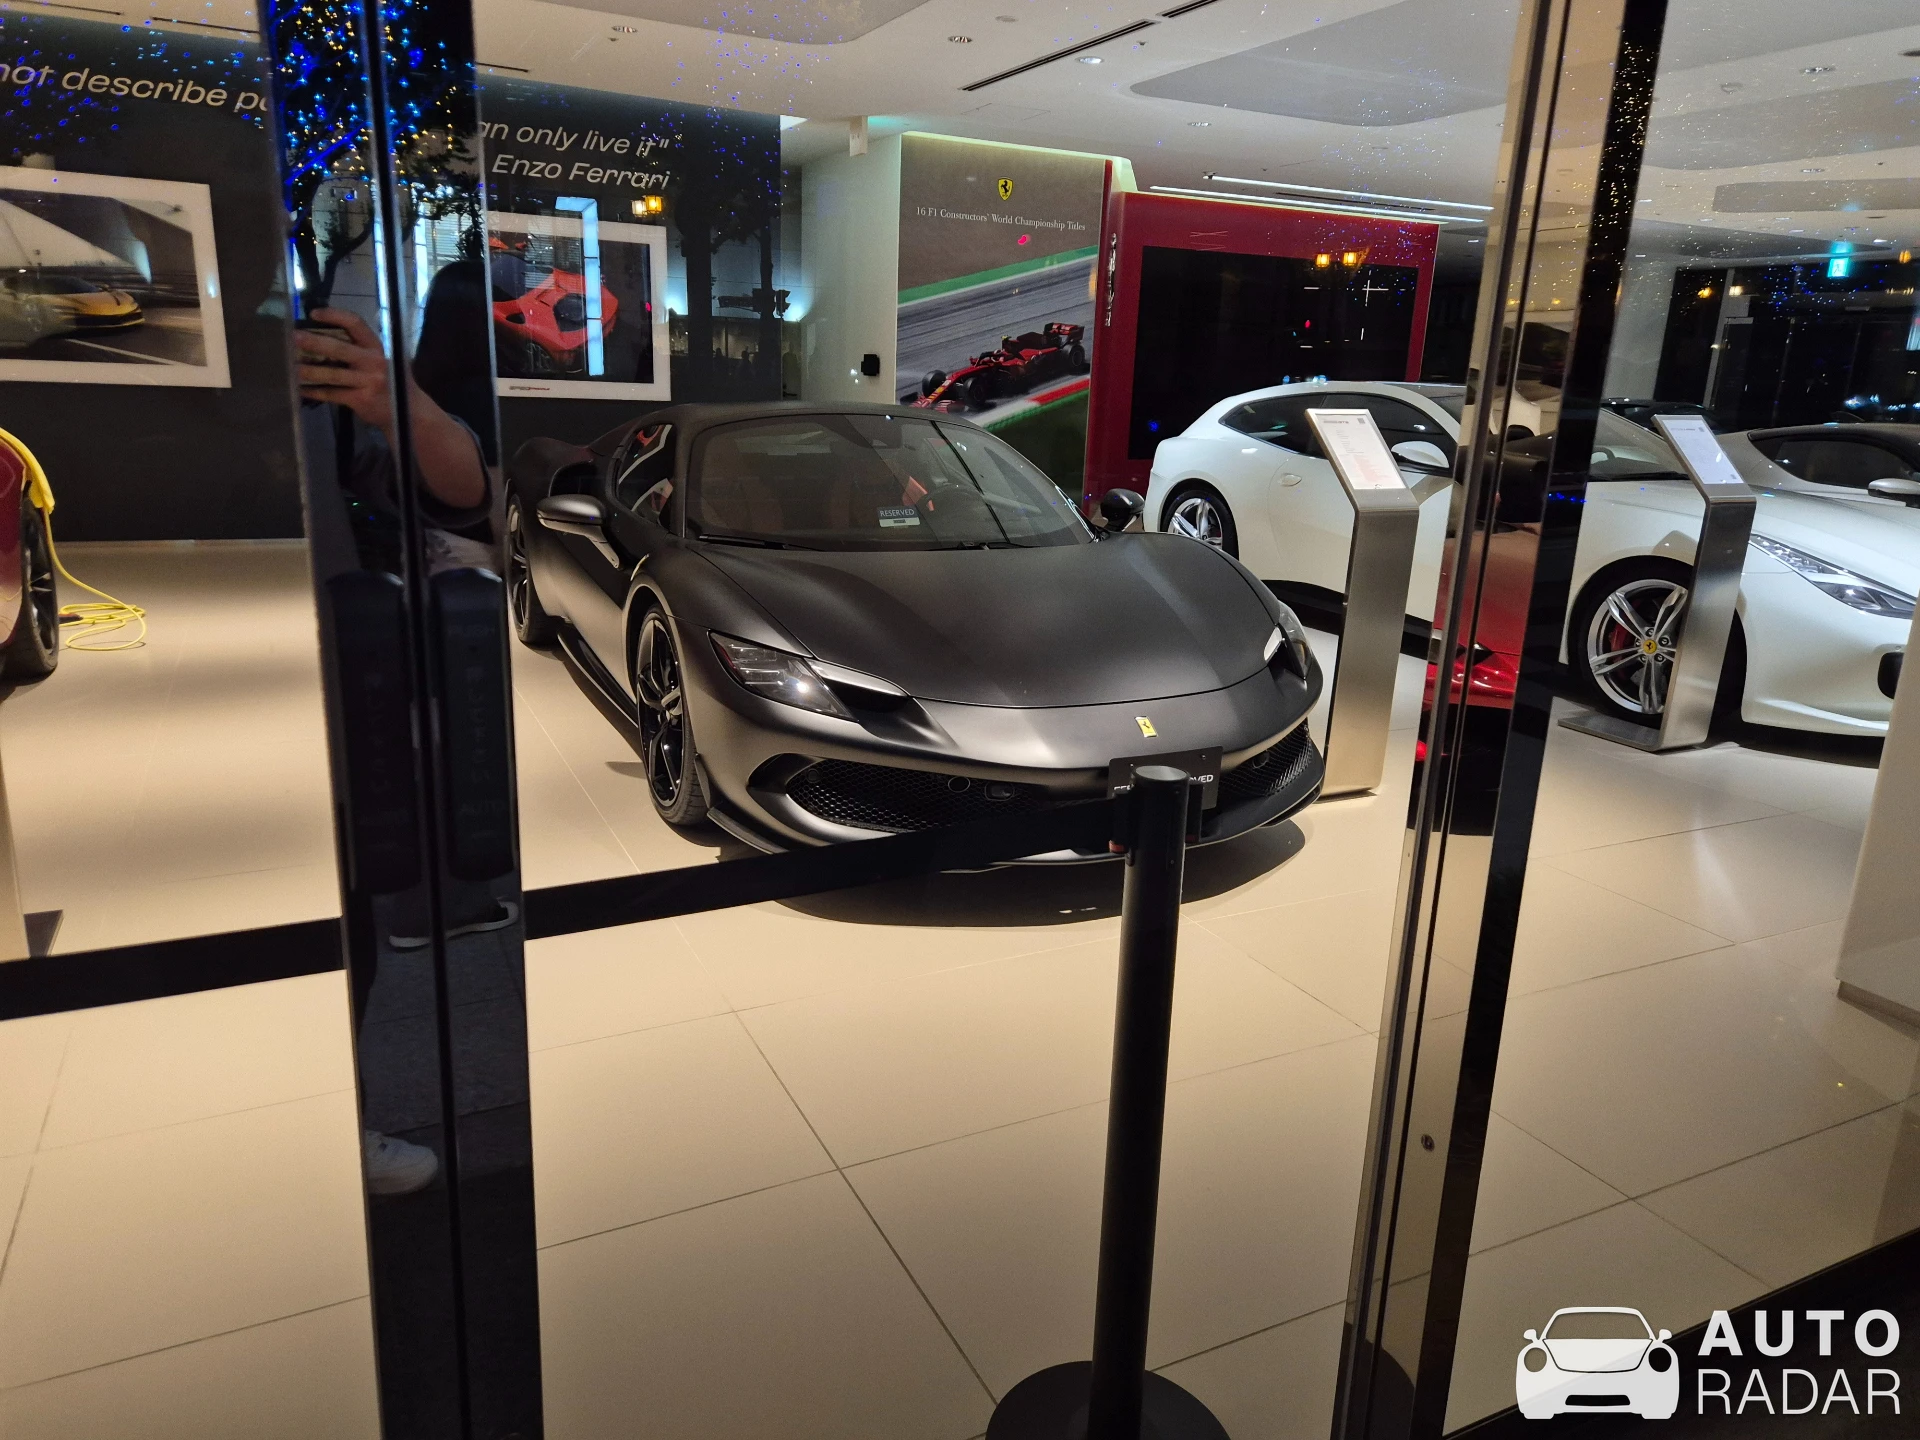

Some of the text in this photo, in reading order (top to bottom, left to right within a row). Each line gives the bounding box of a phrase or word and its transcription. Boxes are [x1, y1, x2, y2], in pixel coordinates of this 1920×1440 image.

[61, 67, 228, 106] describe
[515, 126, 579, 152] only
[582, 129, 631, 154] live
[491, 153, 671, 190] Enzo Ferrari
[916, 206, 926, 216] 16
[927, 207, 937, 217] F1
[991, 213, 1013, 224] World
[1014, 215, 1065, 231] Championship
[1066, 220, 1086, 231] Titles
[879, 508, 915, 517] RESERVED
